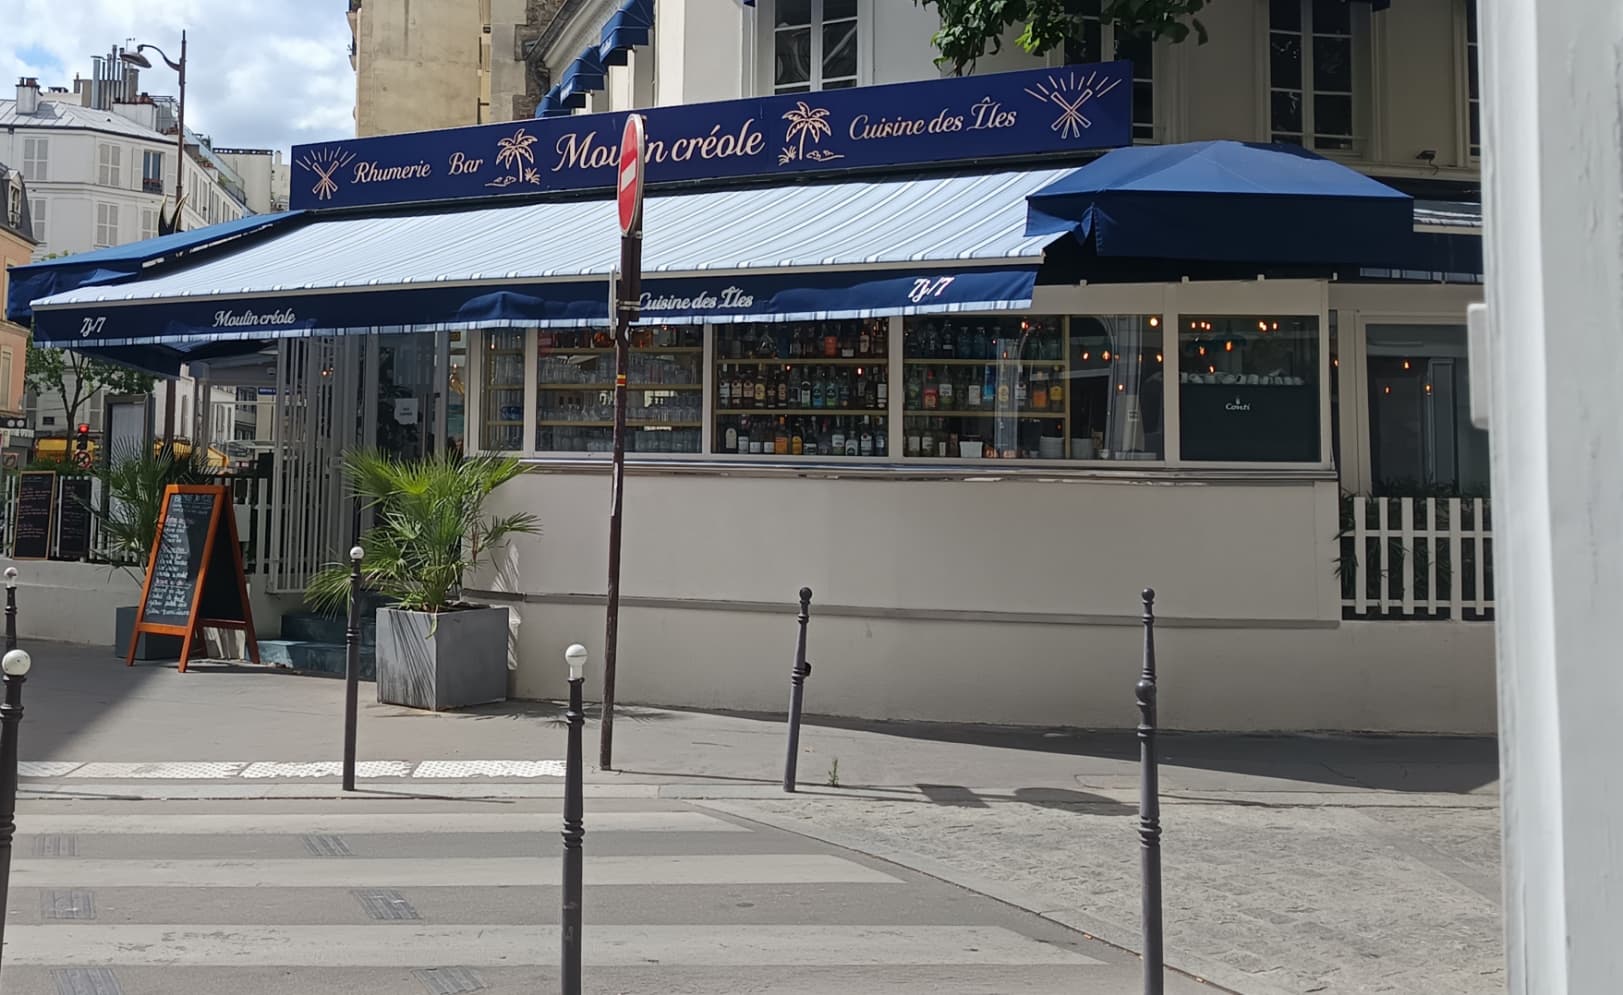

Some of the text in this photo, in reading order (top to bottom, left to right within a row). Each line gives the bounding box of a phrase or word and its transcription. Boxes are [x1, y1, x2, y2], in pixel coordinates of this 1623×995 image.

[850, 96, 1017, 141] Cuisine des Îles
[552, 118, 765, 172] Moun créole
[351, 152, 483, 184] Rhumerie Bar
[640, 286, 754, 311] Cuisine des Îles
[212, 308, 296, 327] Moulin créole
